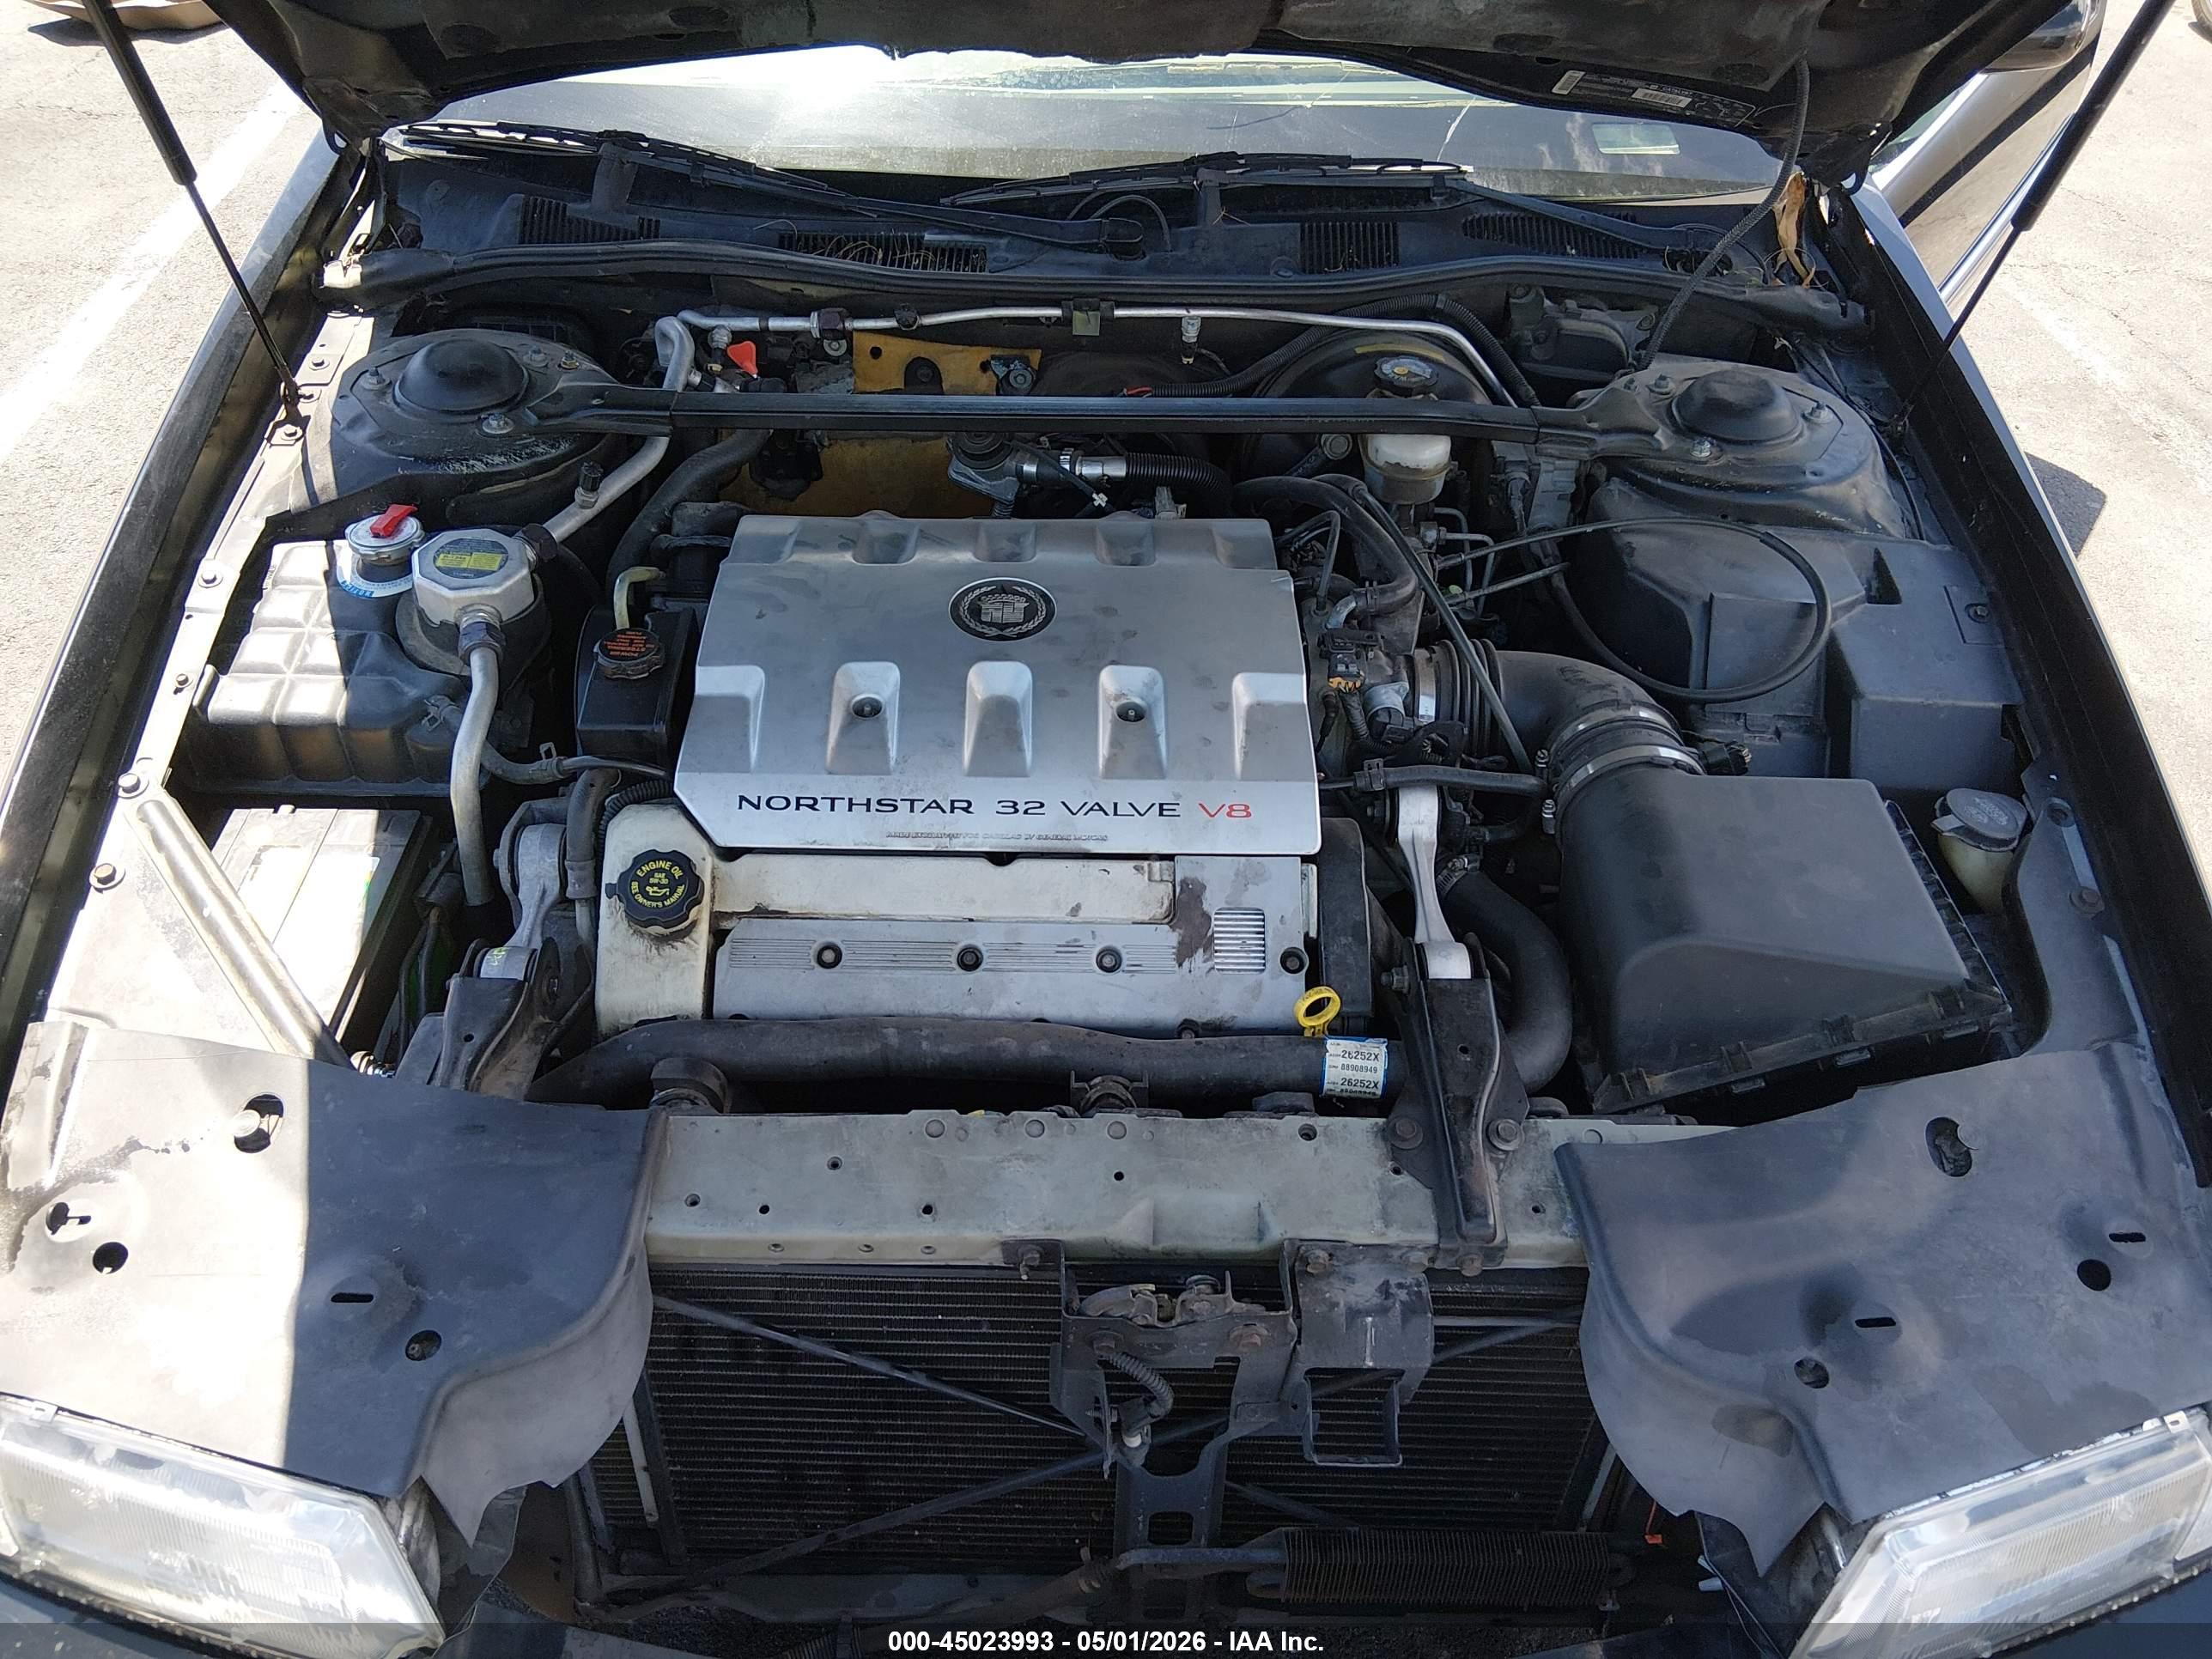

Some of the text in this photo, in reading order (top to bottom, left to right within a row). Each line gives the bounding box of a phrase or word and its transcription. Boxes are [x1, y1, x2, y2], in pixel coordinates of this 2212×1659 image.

[737, 794, 1253, 819] NORTHSTAR 32 VALVE V8
[635, 860, 684, 880] ENGINE OIL
[664, 884, 685, 908] MANUAL
[1340, 1049, 1380, 1062] 26252X
[1340, 1077, 1380, 1090] 26252X
